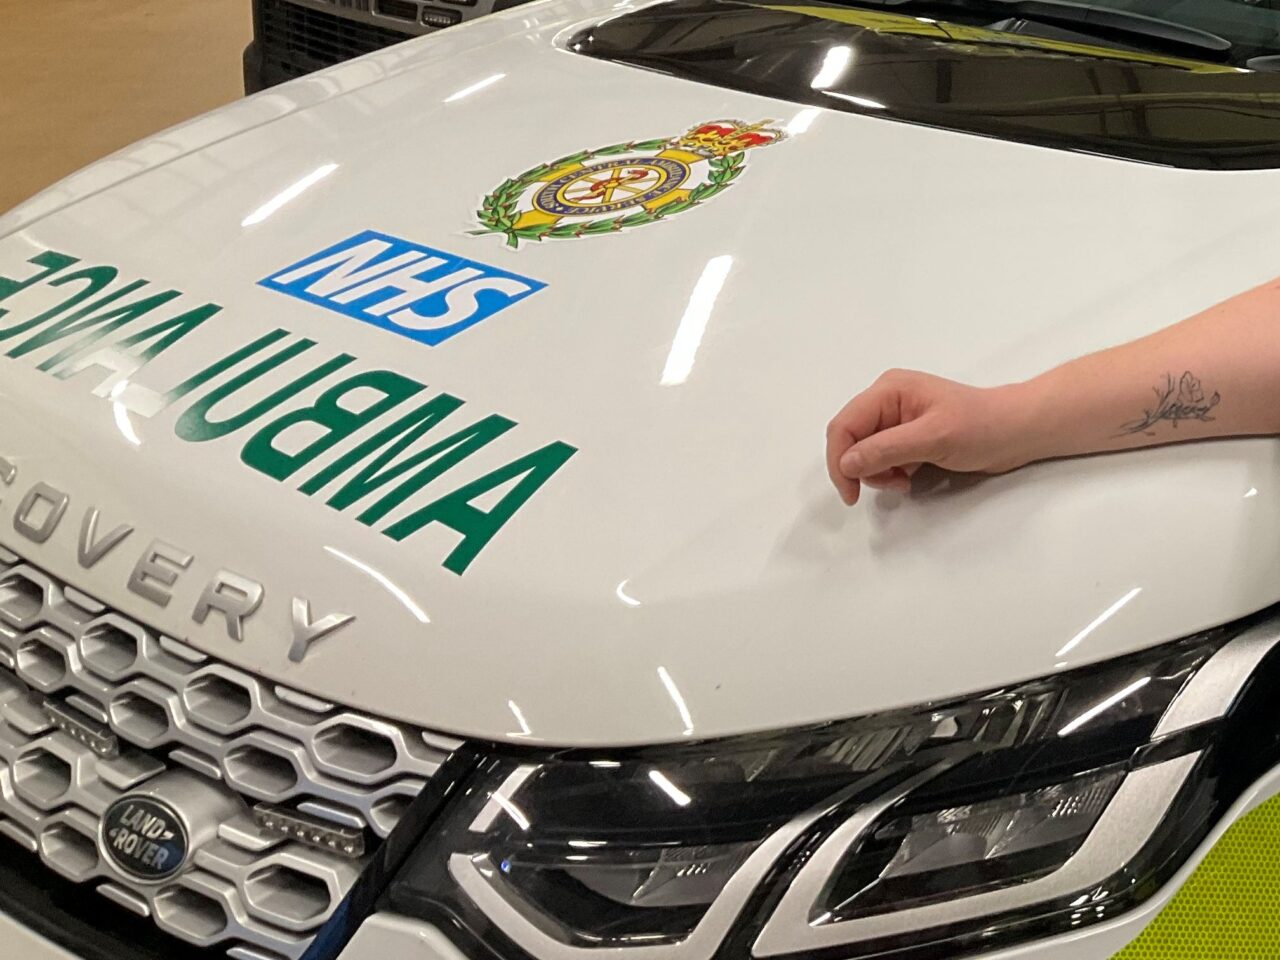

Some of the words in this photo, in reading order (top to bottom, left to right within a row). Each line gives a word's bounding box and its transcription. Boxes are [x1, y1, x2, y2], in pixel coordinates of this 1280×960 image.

[272, 239, 532, 331] NHS
[120, 804, 166, 839] LAND
[113, 827, 169, 870] ROVER
